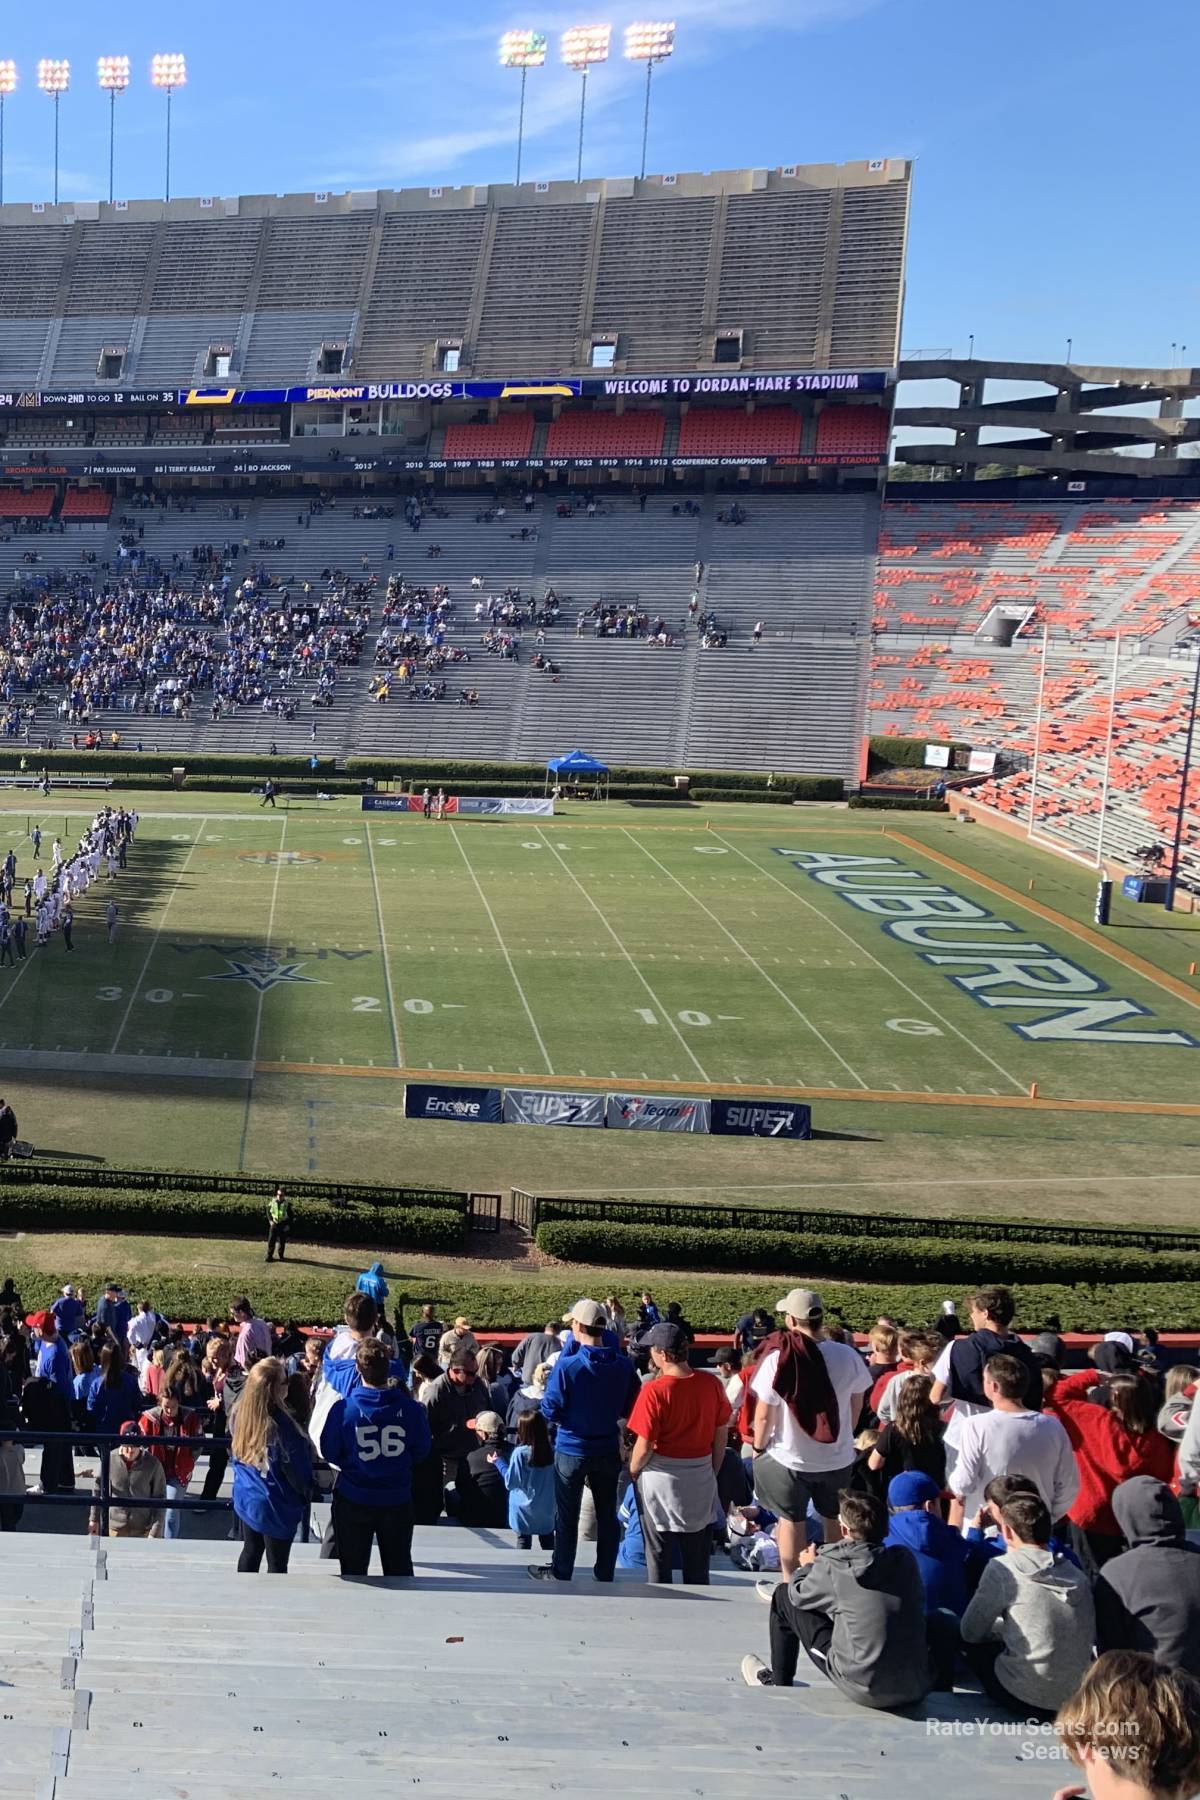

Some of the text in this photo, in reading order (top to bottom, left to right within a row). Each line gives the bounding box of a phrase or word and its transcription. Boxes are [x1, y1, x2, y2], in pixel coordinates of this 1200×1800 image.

[307, 383, 453, 399] PIEDMONT BULLDOGS
[604, 374, 859, 394] WELCOME TO JORDAN-HARE STADIUM
[43, 392, 174, 404] DOWN 2ND TO GO 12 BALL ON 35
[672, 458, 719, 466] CONFERENCE
[840, 456, 881, 464] STADIUM
[772, 848, 1194, 1047] AUBURN
[96, 986, 174, 1003] 30
[351, 996, 434, 1015] 20
[634, 1008, 712, 1027] 10
[885, 1018, 945, 1036] G
[425, 1096, 481, 1114] Encore
[425, 1335, 436, 1348] 6
[356, 1424, 406, 1462] 56
